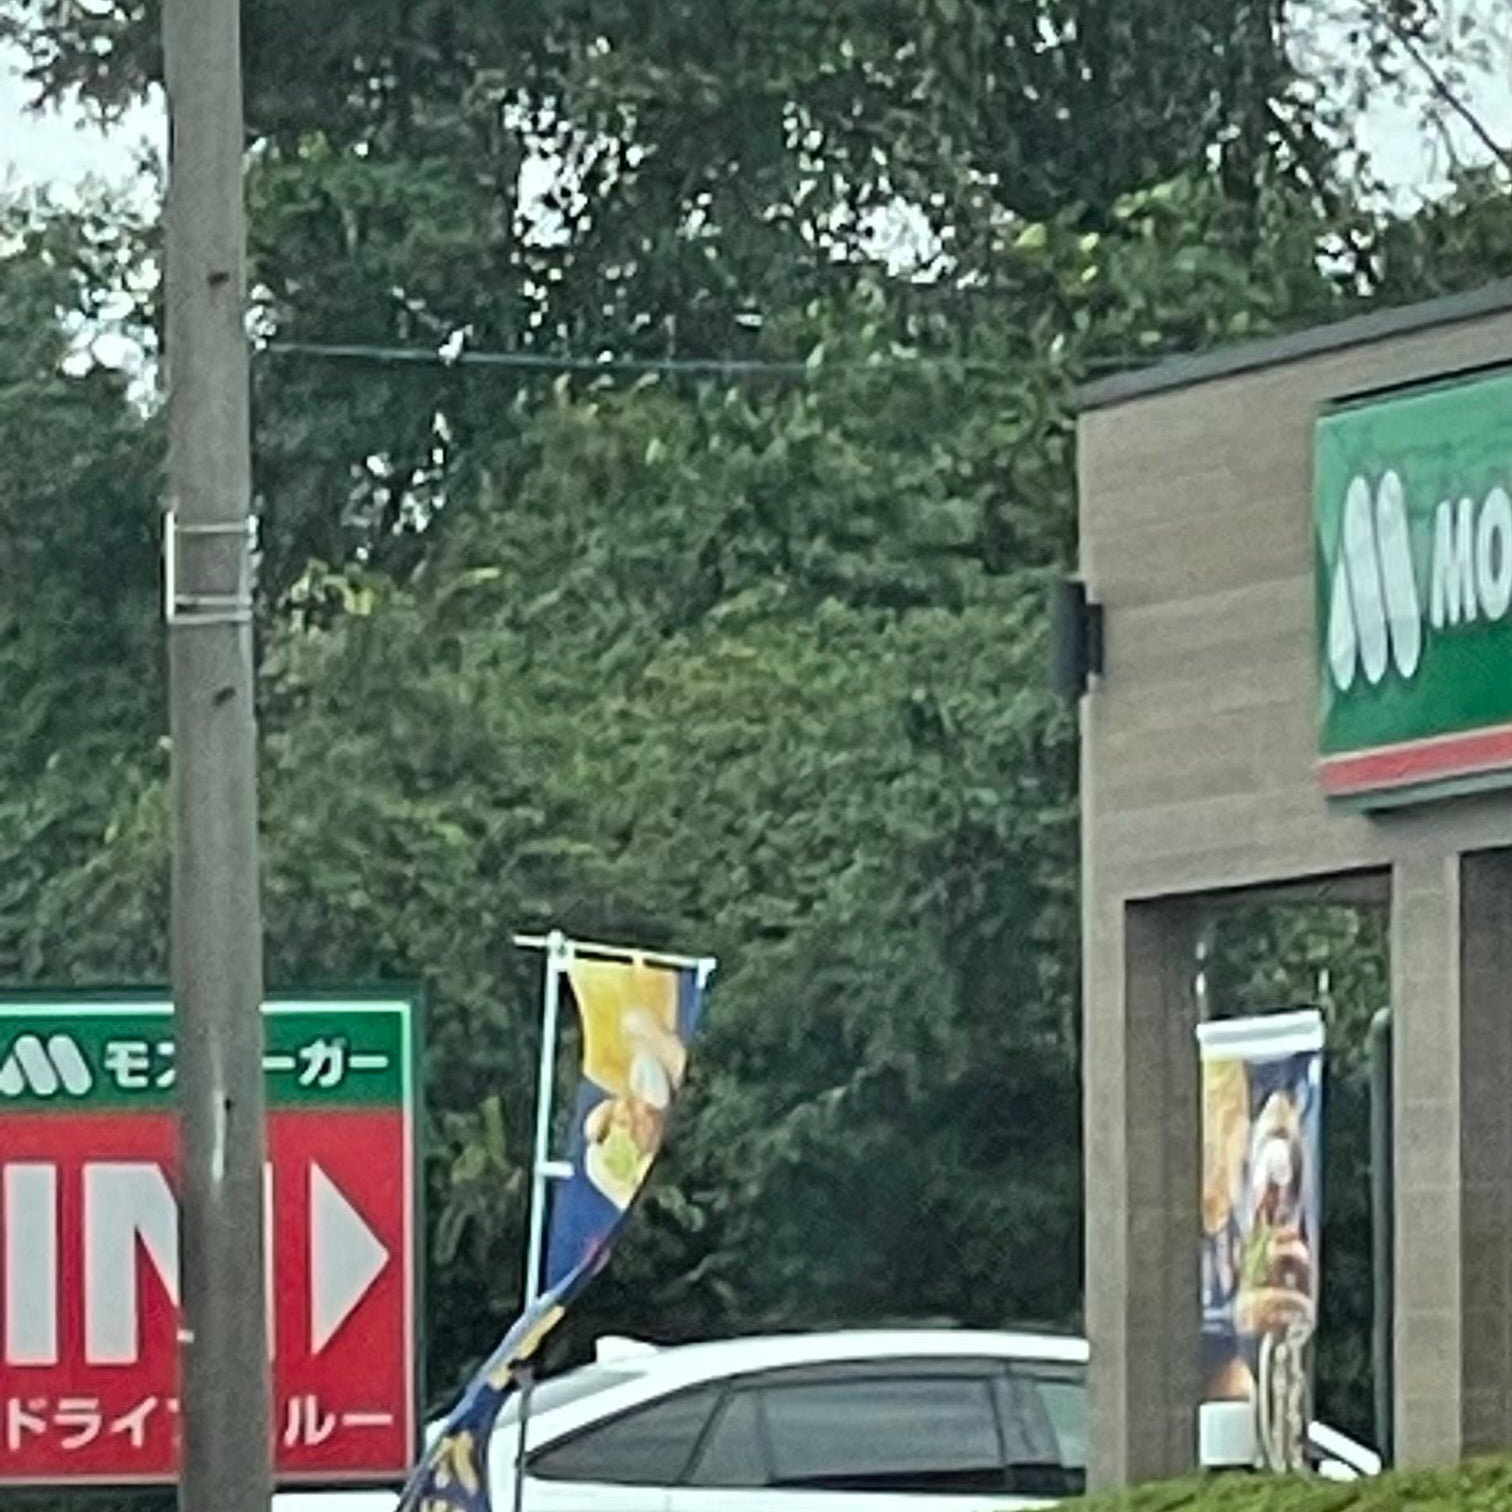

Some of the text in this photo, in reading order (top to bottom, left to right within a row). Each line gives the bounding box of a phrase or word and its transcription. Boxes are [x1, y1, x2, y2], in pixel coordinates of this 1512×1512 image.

[104, 1037, 390, 1088] モーガー
[8, 1394, 394, 1452] ドライルー
